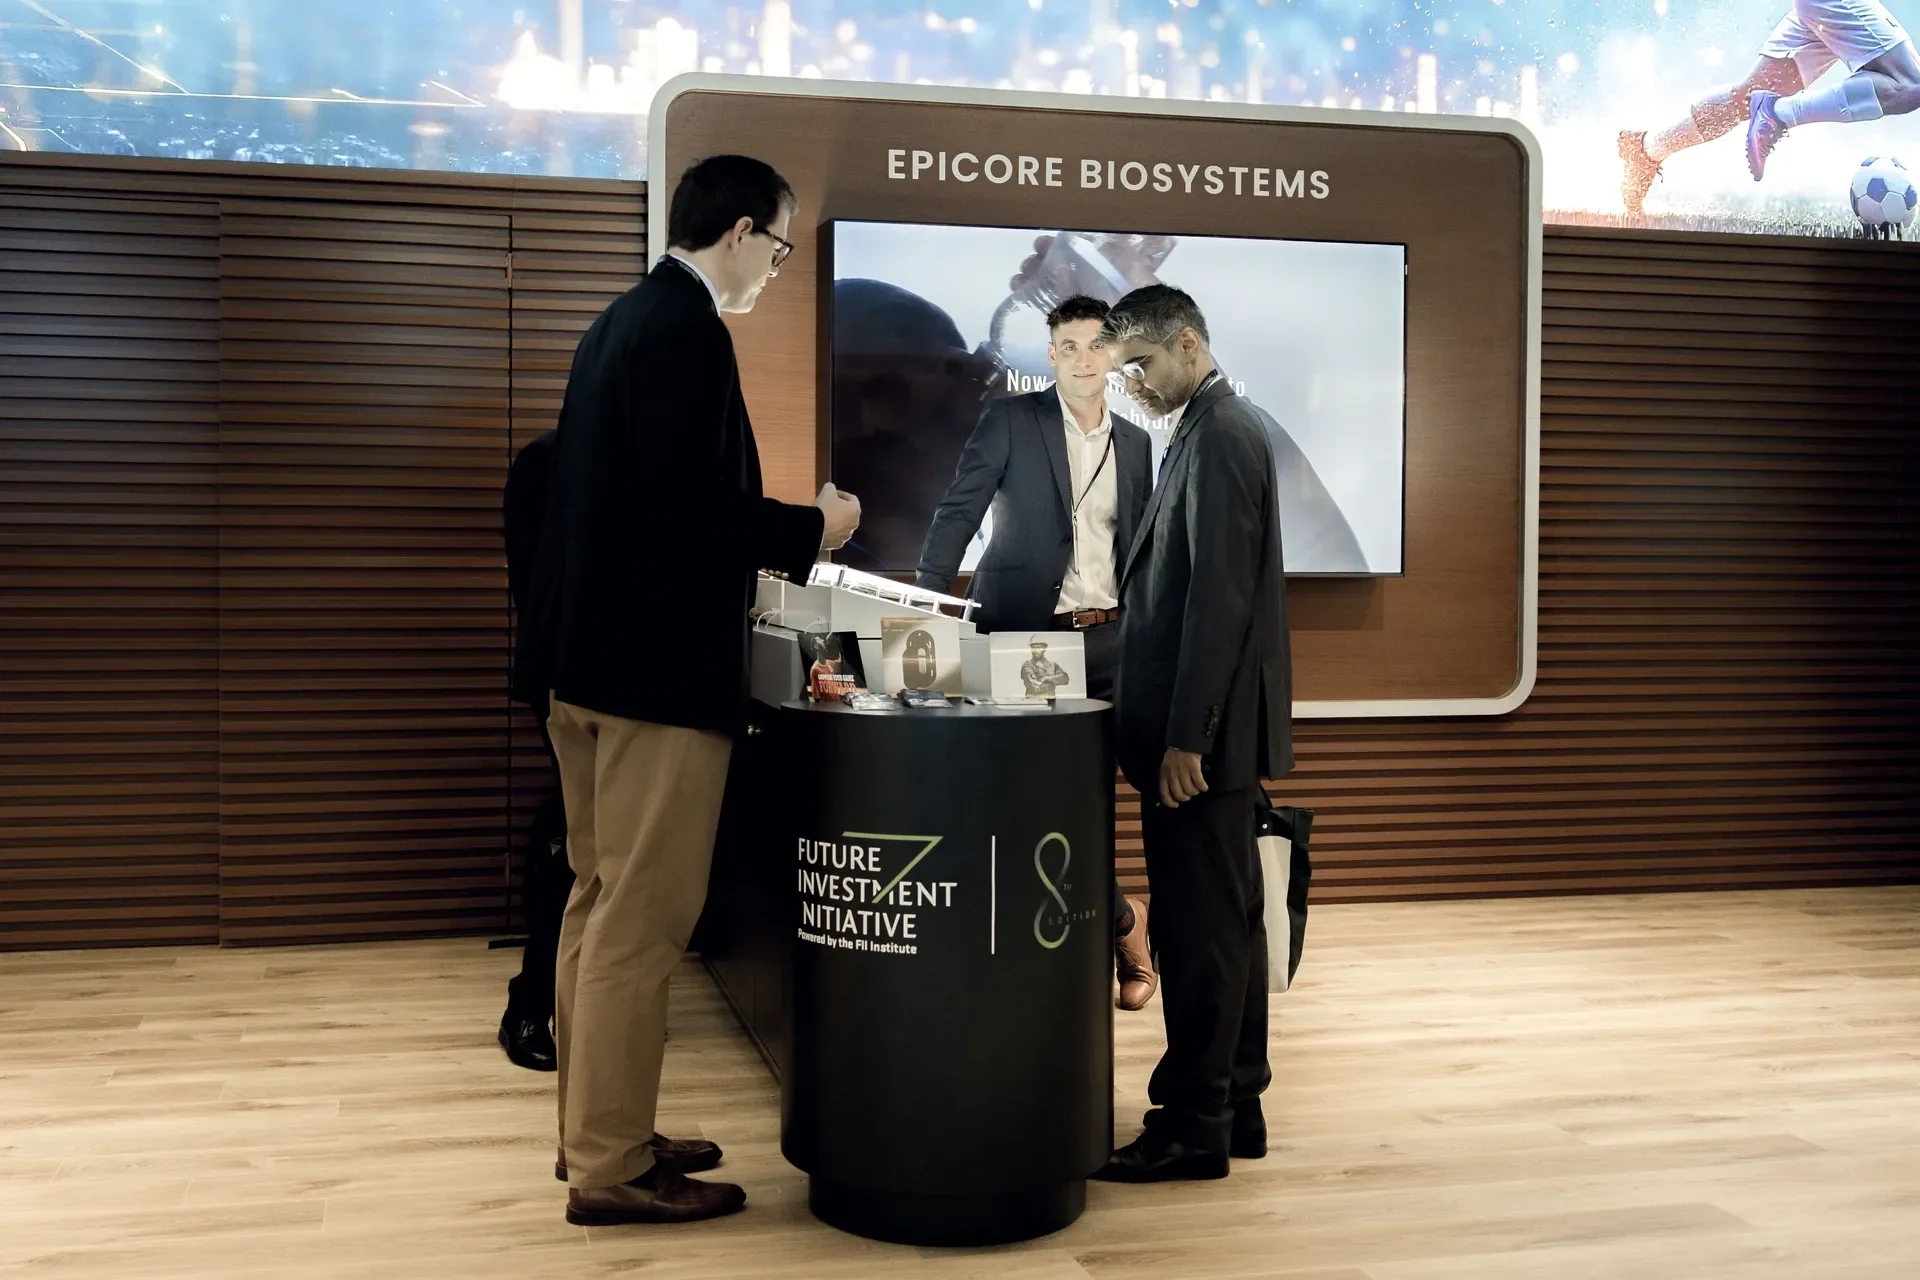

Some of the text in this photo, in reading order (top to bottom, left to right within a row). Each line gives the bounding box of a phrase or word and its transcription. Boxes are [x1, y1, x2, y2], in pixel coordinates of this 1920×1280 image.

[887, 148, 1330, 199] EPICORE BIOSYSTEMS
[1007, 369, 1047, 392] Now
[798, 837, 882, 872] FUTURE
[798, 869, 958, 907] INVESTMENT
[798, 928, 918, 954] Powered by the FII Institute
